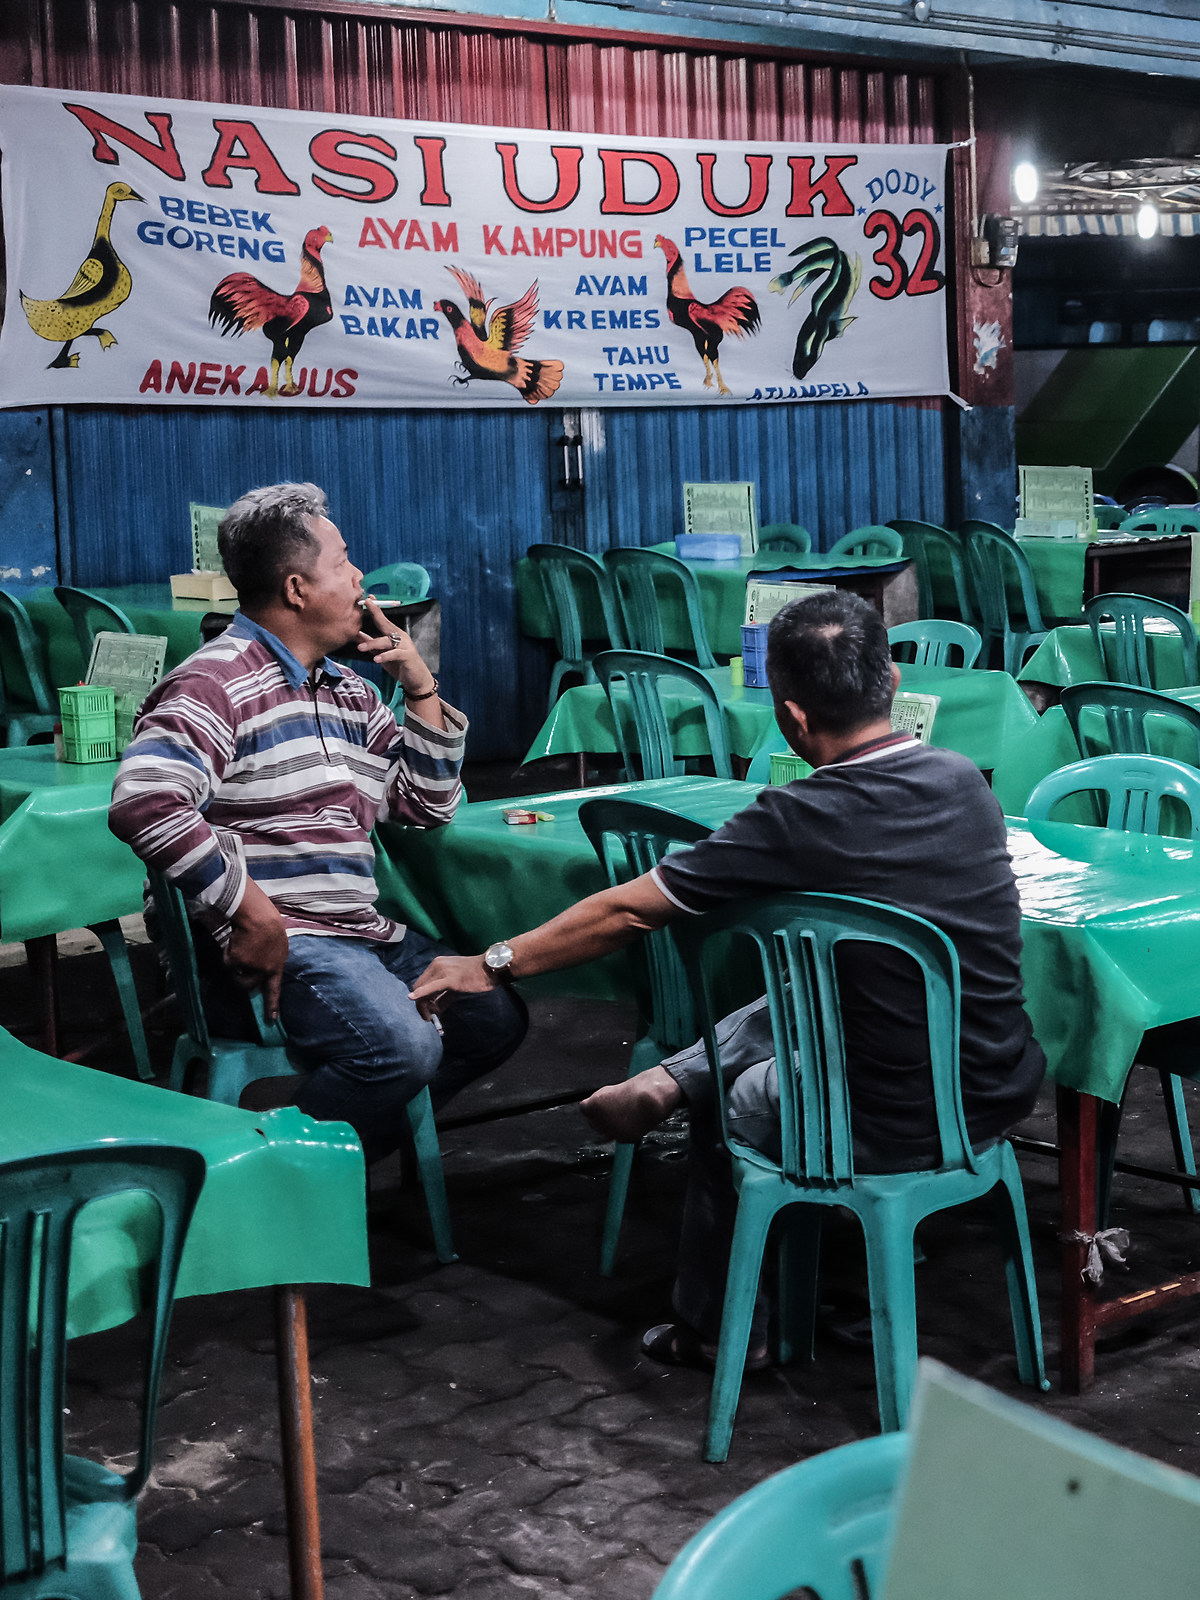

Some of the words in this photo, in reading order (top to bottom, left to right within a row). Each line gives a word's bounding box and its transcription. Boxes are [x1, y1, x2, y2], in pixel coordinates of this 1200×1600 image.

[62, 102, 452, 207] NASI
[495, 142, 858, 217] UDUK
[865, 168, 938, 204] DODY
[159, 195, 276, 235] BEBEK
[136, 220, 286, 263] GORENG
[358, 217, 459, 253] AYAM
[482, 224, 643, 259] KAMPUNG
[684, 227, 786, 248] PECEL
[694, 252, 772, 274] LELE
[864, 209, 946, 301] 32
[343, 285, 424, 311] AYAM
[575, 275, 648, 297] AYAM
[339, 314, 440, 340] BAKAR
[543, 310, 661, 330] KREMES
[602, 346, 670, 366] TAHU
[139, 359, 271, 397] ANEKA
[278, 367, 359, 398] JUS
[594, 373, 682, 393] TEMPE
